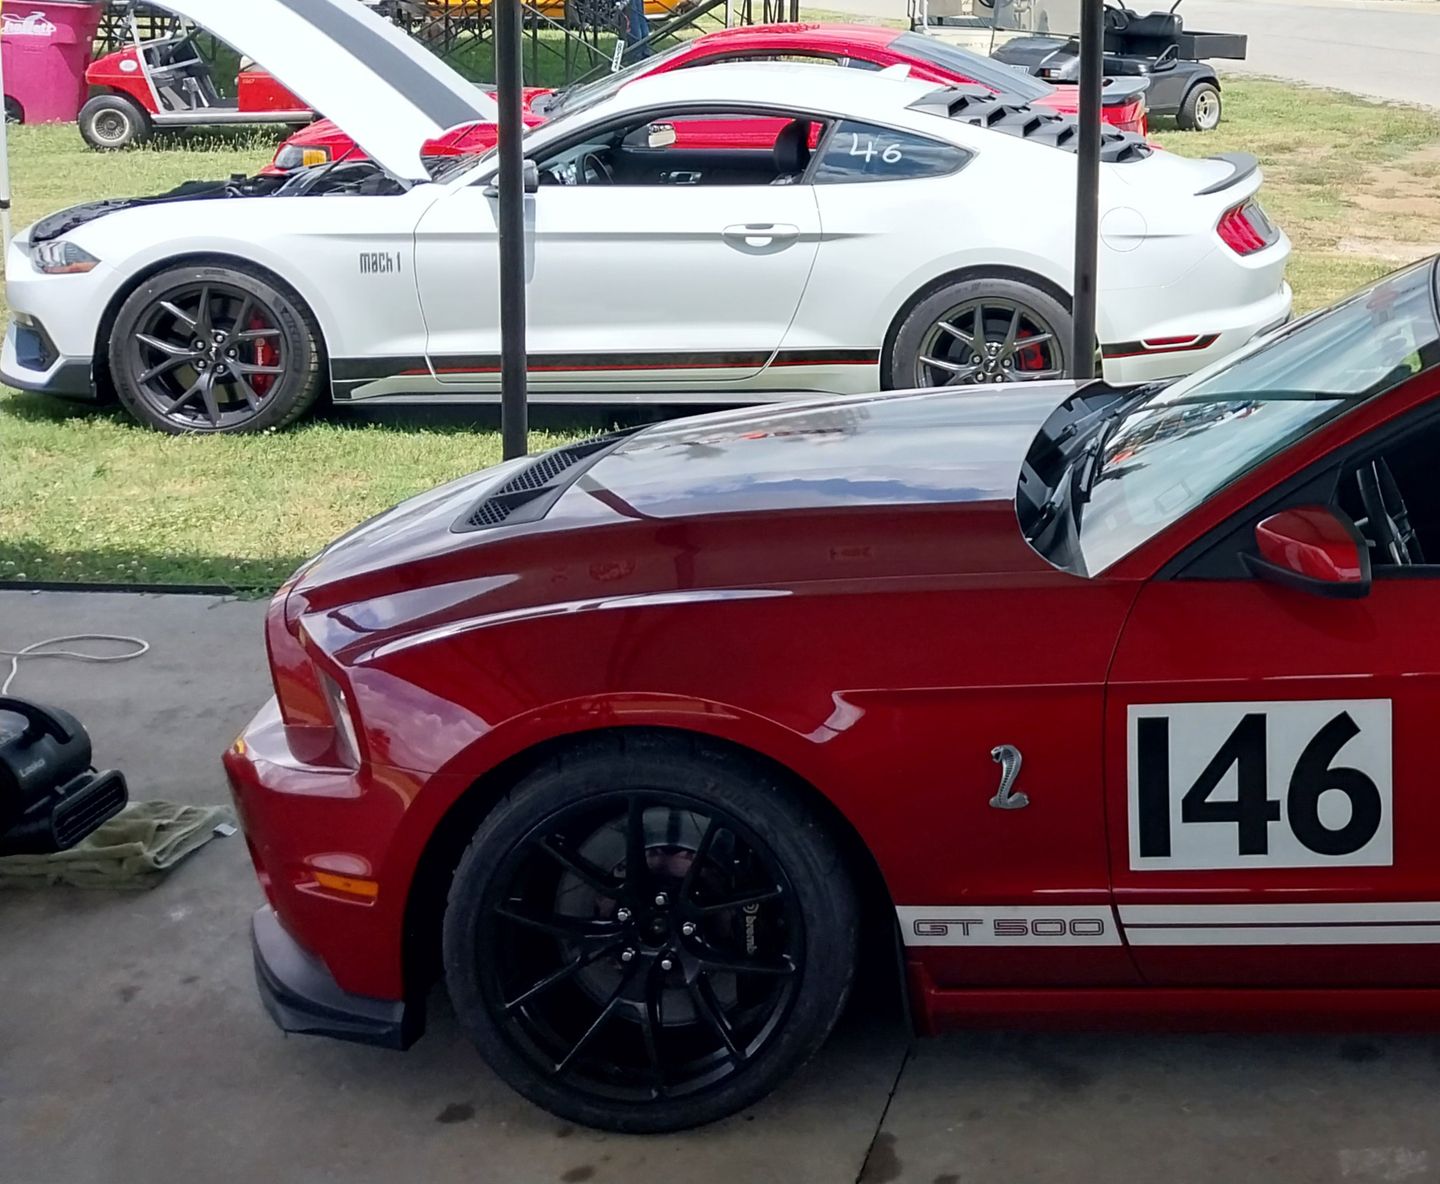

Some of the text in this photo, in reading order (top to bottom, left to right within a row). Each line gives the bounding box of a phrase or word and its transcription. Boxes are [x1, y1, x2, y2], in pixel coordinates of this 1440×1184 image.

[849, 133, 902, 163] 46
[1137, 710, 1382, 858] 146
[913, 918, 1105, 937] GT 500
